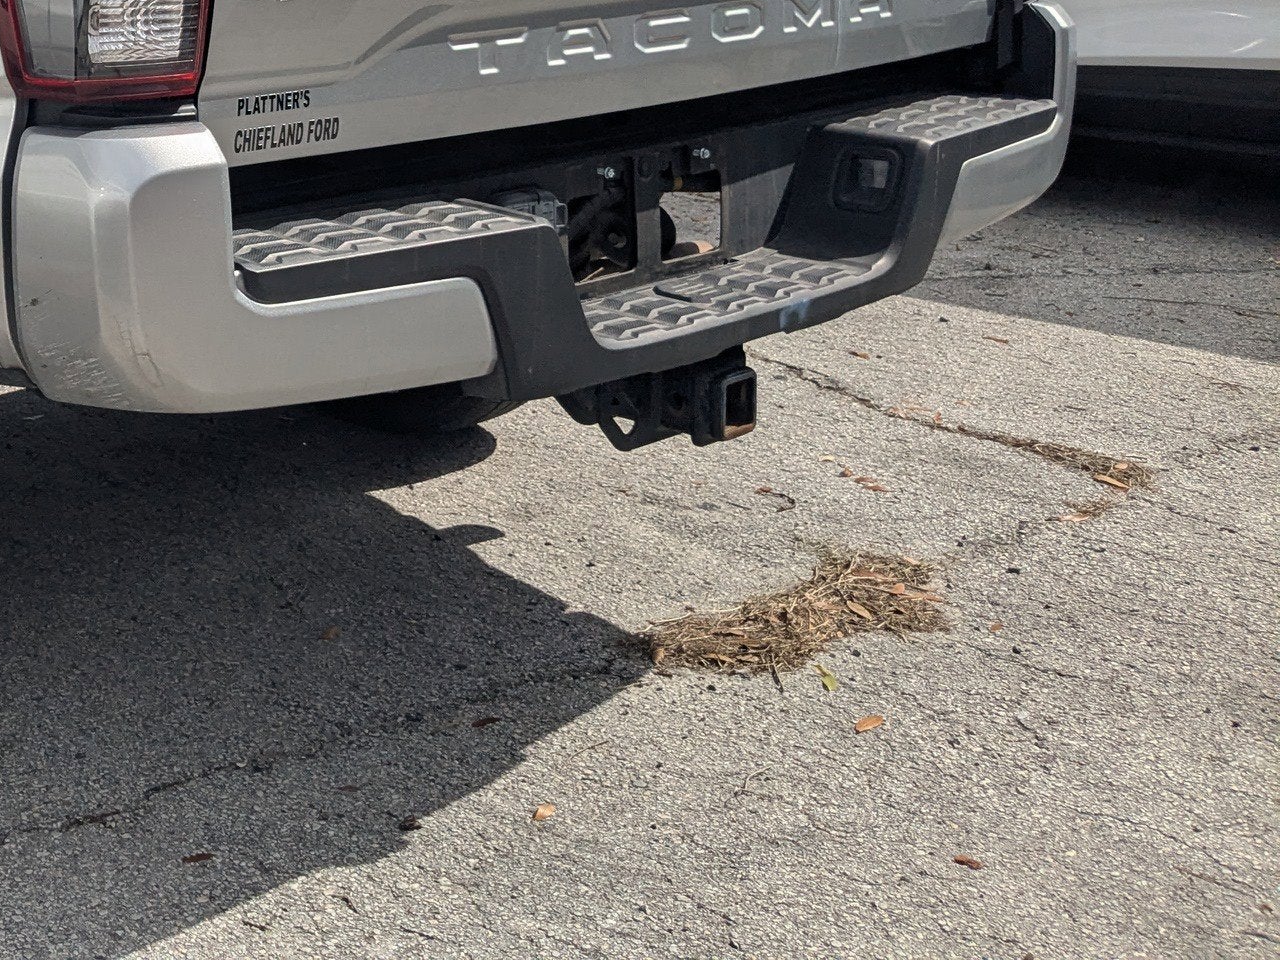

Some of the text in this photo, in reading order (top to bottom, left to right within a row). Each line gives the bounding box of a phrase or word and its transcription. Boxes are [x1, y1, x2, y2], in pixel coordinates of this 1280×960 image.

[236, 89, 311, 117] PLATTNER'S
[234, 116, 340, 154] CHIEFLAND FORD
